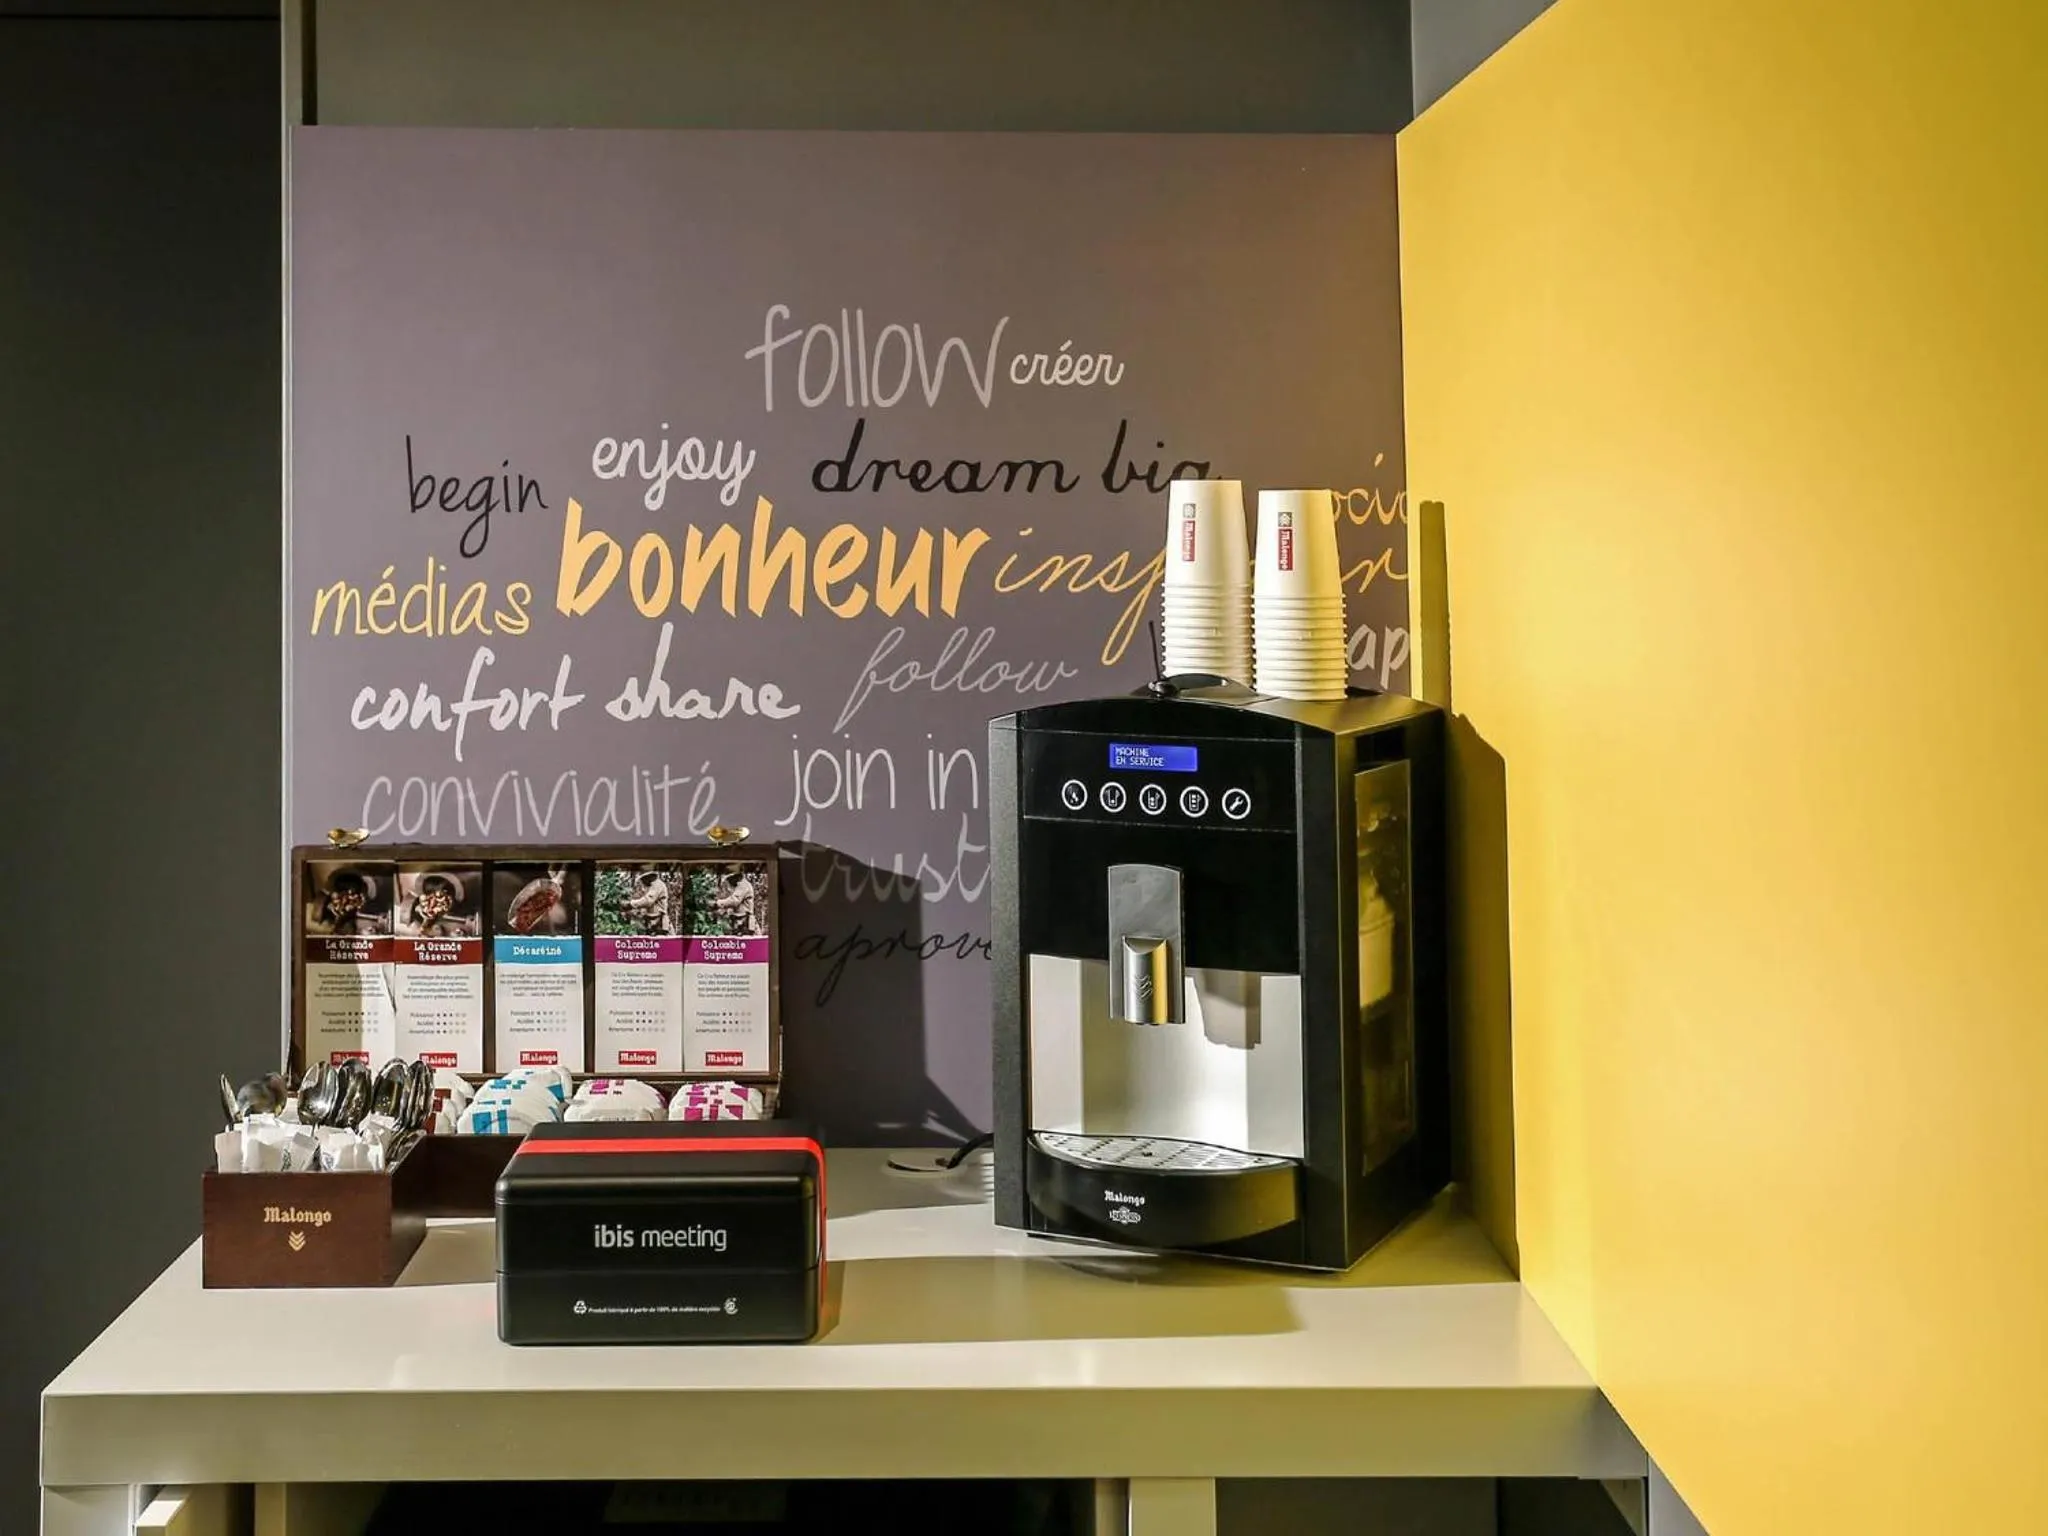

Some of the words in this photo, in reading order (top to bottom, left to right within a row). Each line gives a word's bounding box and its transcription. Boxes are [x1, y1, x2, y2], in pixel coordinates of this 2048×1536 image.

[744, 304, 1010, 412] follow
[1010, 340, 1124, 387] créer
[592, 422, 756, 510] enjoy
[811, 418, 1080, 494] dream
[406, 434, 549, 558] begin
[556, 496, 992, 618] bonheur
[311, 556, 533, 638] médias
[605, 621, 801, 721] share
[833, 626, 1078, 733] follow
[350, 646, 585, 761] confort
[1115, 747, 1149, 757] MACHINE
[1115, 757, 1126, 765] EN
[1130, 757, 1164, 766] SERVICE
[774, 733, 896, 825] join
[926, 733, 979, 810] in
[363, 760, 719, 837] convivialité
[801, 812, 990, 902] trust
[339, 940, 374, 950] Grande
[414, 941, 426, 951] La
[428, 941, 462, 951] Grande
[418, 951, 458, 961] Réserve
[615, 940, 660, 949] Colombie
[617, 950, 658, 961] Supremo
[701, 940, 746, 950] Colombie
[704, 951, 744, 961] Supremo
[521, 1053, 557, 1064] Malongo
[619, 1053, 656, 1064] Malongo
[707, 1054, 743, 1065] Malongo
[1104, 1190, 1145, 1206] Malongo
[263, 1207, 332, 1227] Malongo
[594, 1224, 634, 1248] ibis
[641, 1224, 727, 1251] meeting
